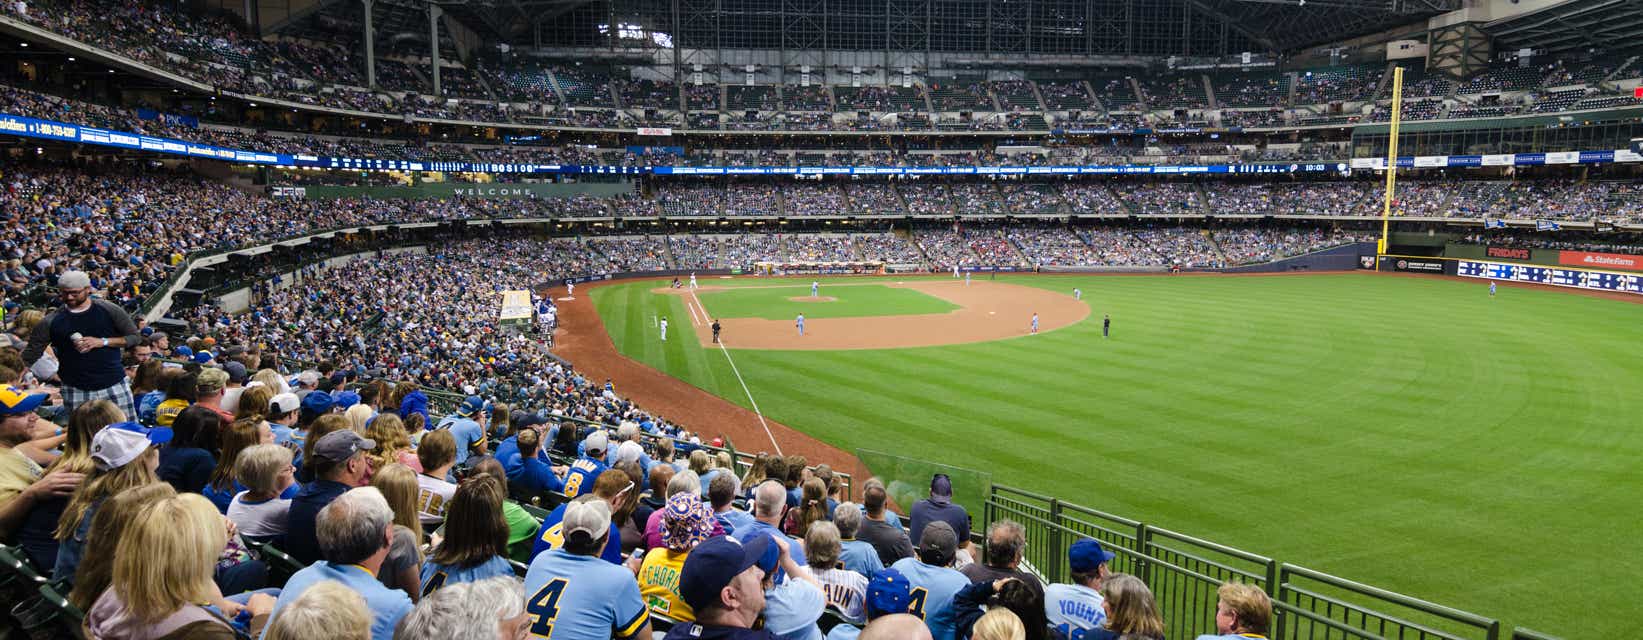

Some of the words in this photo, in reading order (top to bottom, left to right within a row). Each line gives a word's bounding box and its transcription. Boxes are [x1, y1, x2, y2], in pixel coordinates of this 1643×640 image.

[454, 188, 531, 196] WELCOME
[564, 472, 584, 497] 8
[526, 577, 569, 638] 4
[824, 583, 855, 608] AUN
[906, 586, 928, 622] 4
[1059, 599, 1105, 625] YOUNT
